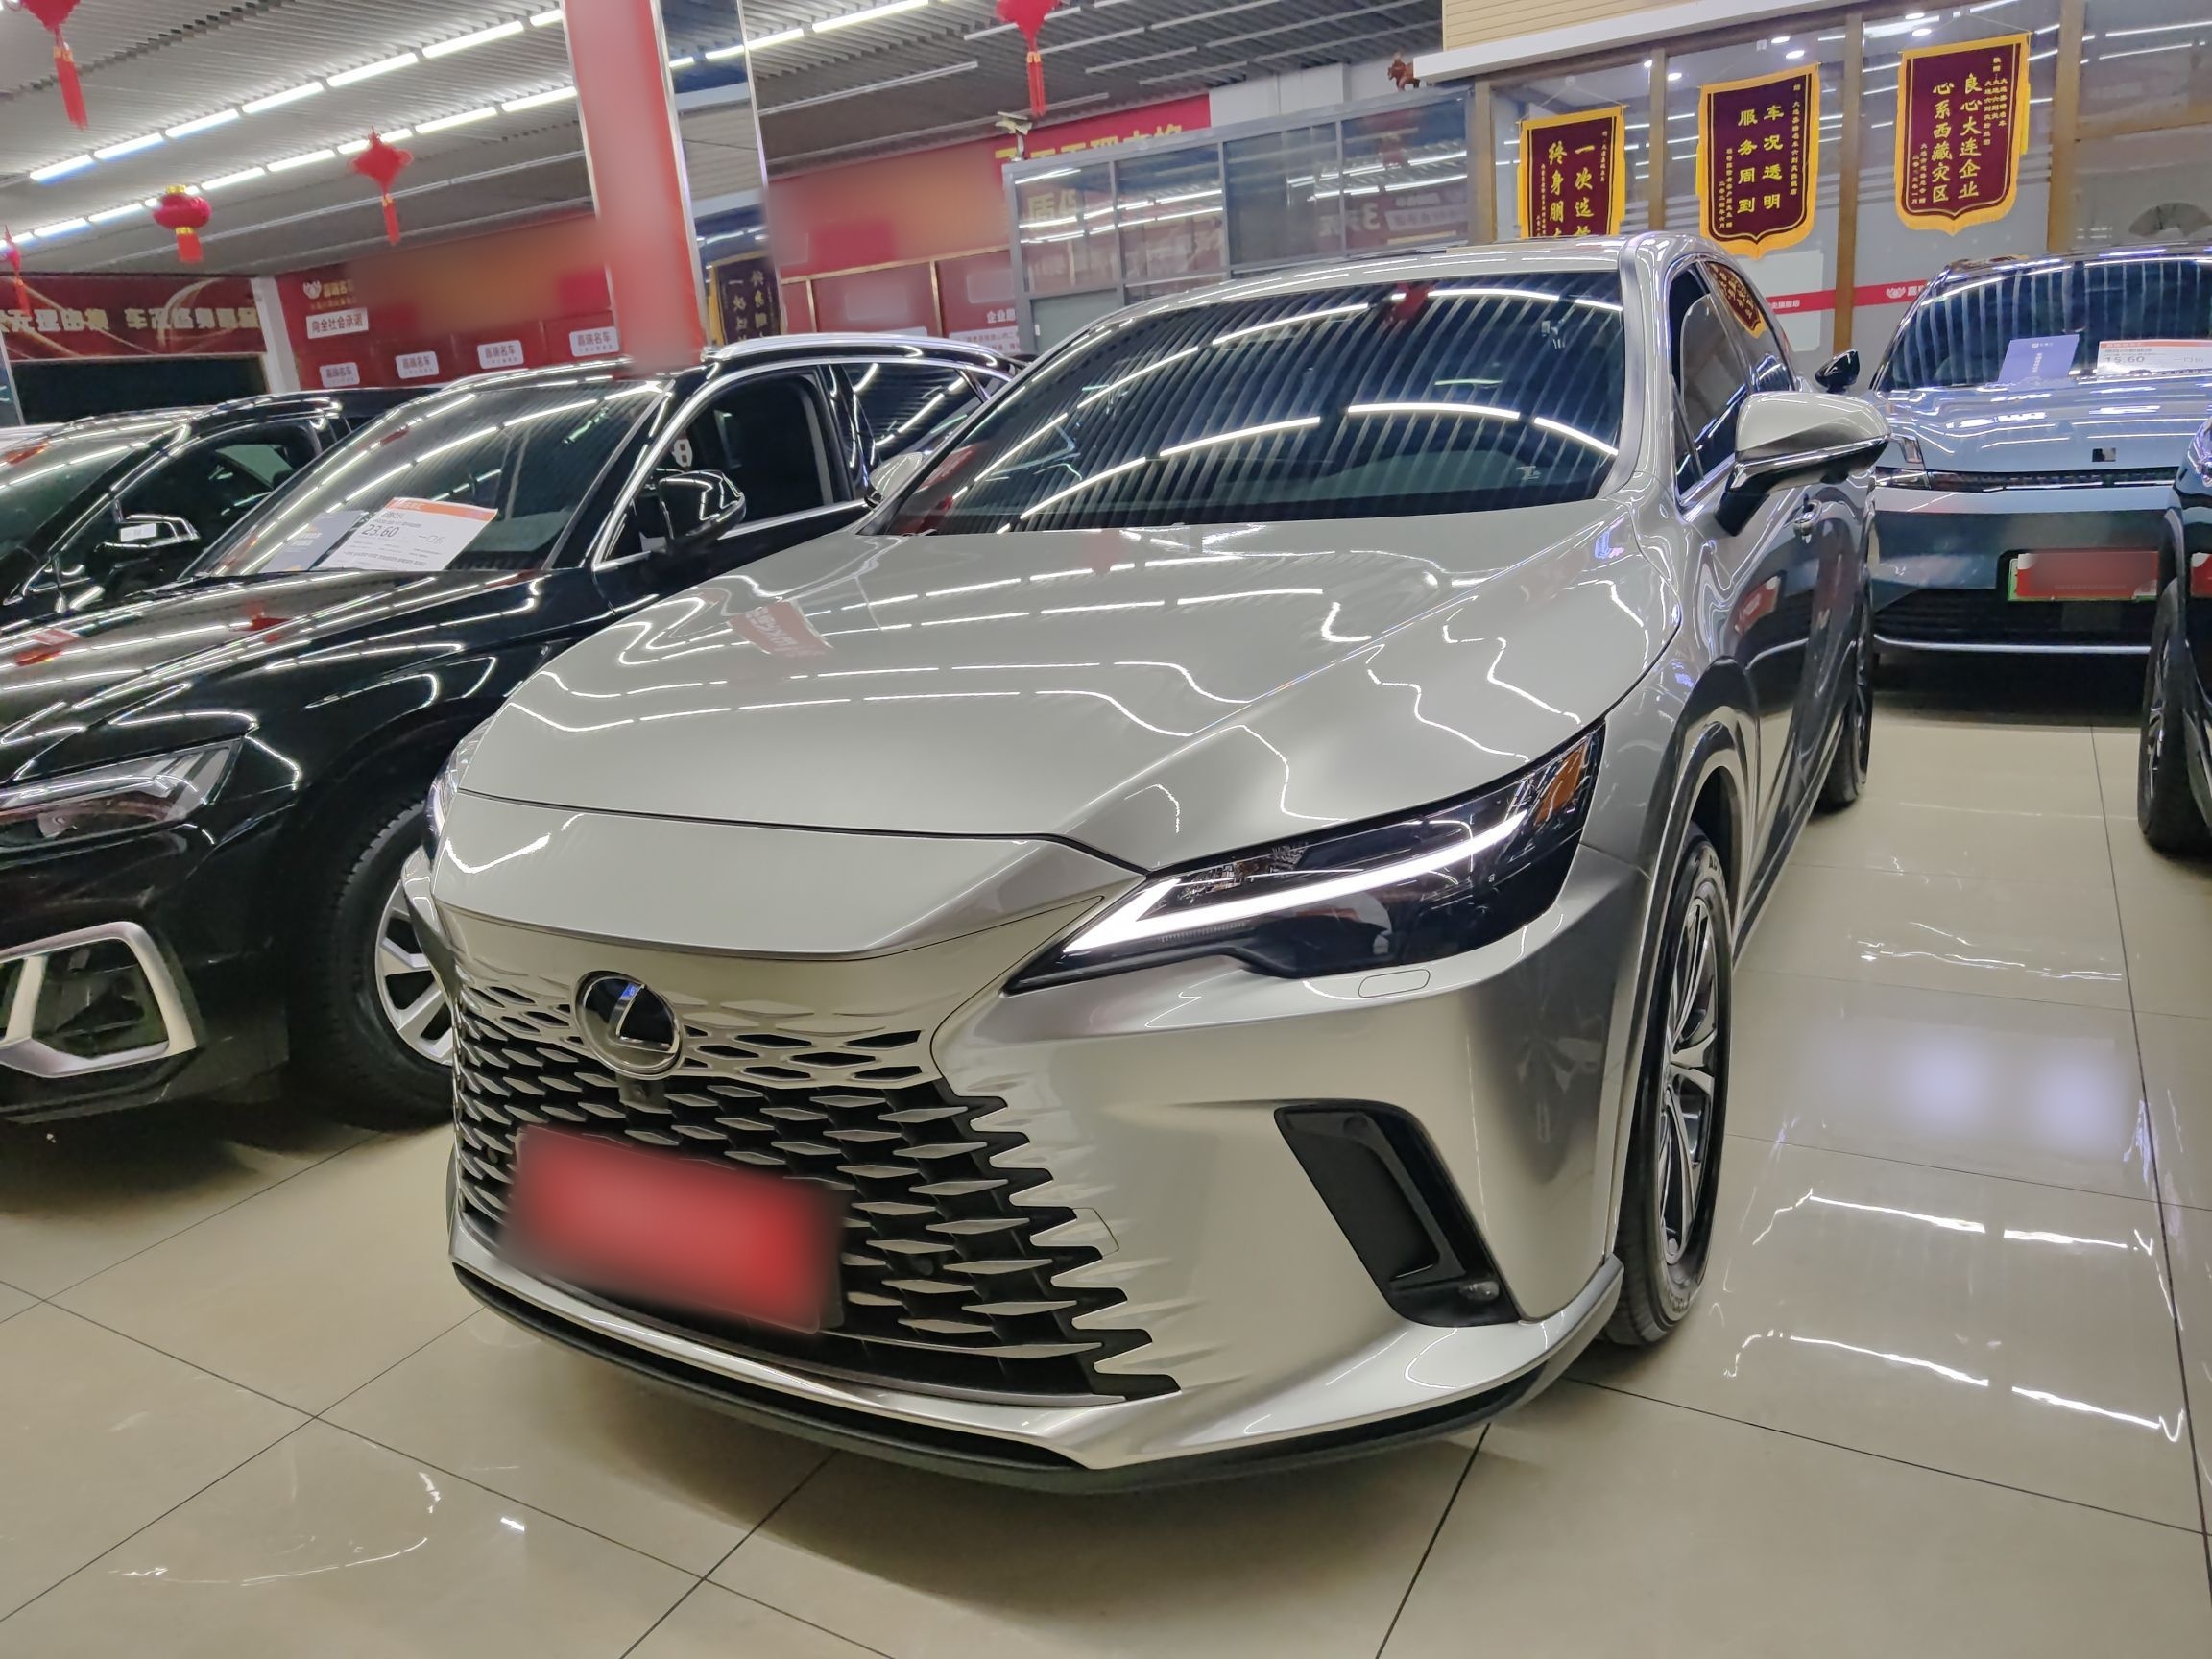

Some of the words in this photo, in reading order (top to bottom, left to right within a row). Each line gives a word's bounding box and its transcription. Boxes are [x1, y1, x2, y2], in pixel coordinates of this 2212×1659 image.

[1737, 108, 1758, 214] 服务周到
[1762, 105, 1784, 210] 车况透明
[1931, 82, 1954, 203] 心系西藏灾区
[1959, 73, 1983, 199] 良心大连企业
[361, 523, 400, 538] 23.60
